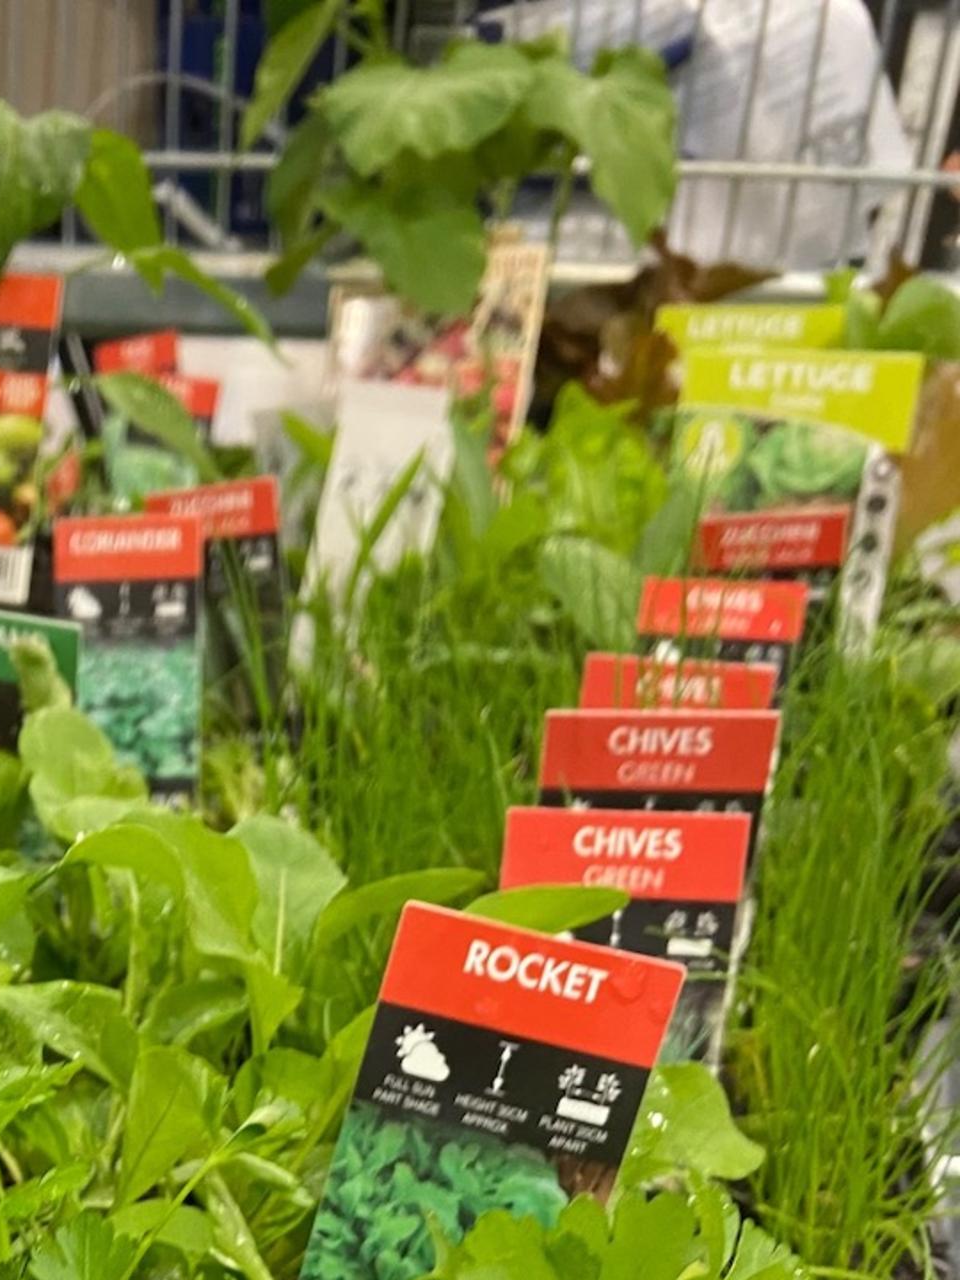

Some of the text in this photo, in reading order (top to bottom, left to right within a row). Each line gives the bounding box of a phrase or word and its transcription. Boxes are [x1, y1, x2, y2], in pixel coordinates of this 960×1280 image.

[688, 313, 804, 339] LETTUCE
[729, 360, 874, 394] LETTUCE
[68, 527, 181, 556] CORIANDER
[607, 725, 714, 757] CHIVES
[616, 760, 695, 785] GREEN
[572, 825, 683, 860] CHIVES
[582, 864, 664, 890] GREEN
[463, 939, 608, 1004] ROCKET
[384, 1073, 409, 1091] FULL
[372, 1087, 403, 1107] PART
[454, 1093, 496, 1116] HEIGHT
[462, 1112, 508, 1134] APPROX
[538, 1115, 575, 1134] PLANT
[549, 1135, 588, 1153] APART
